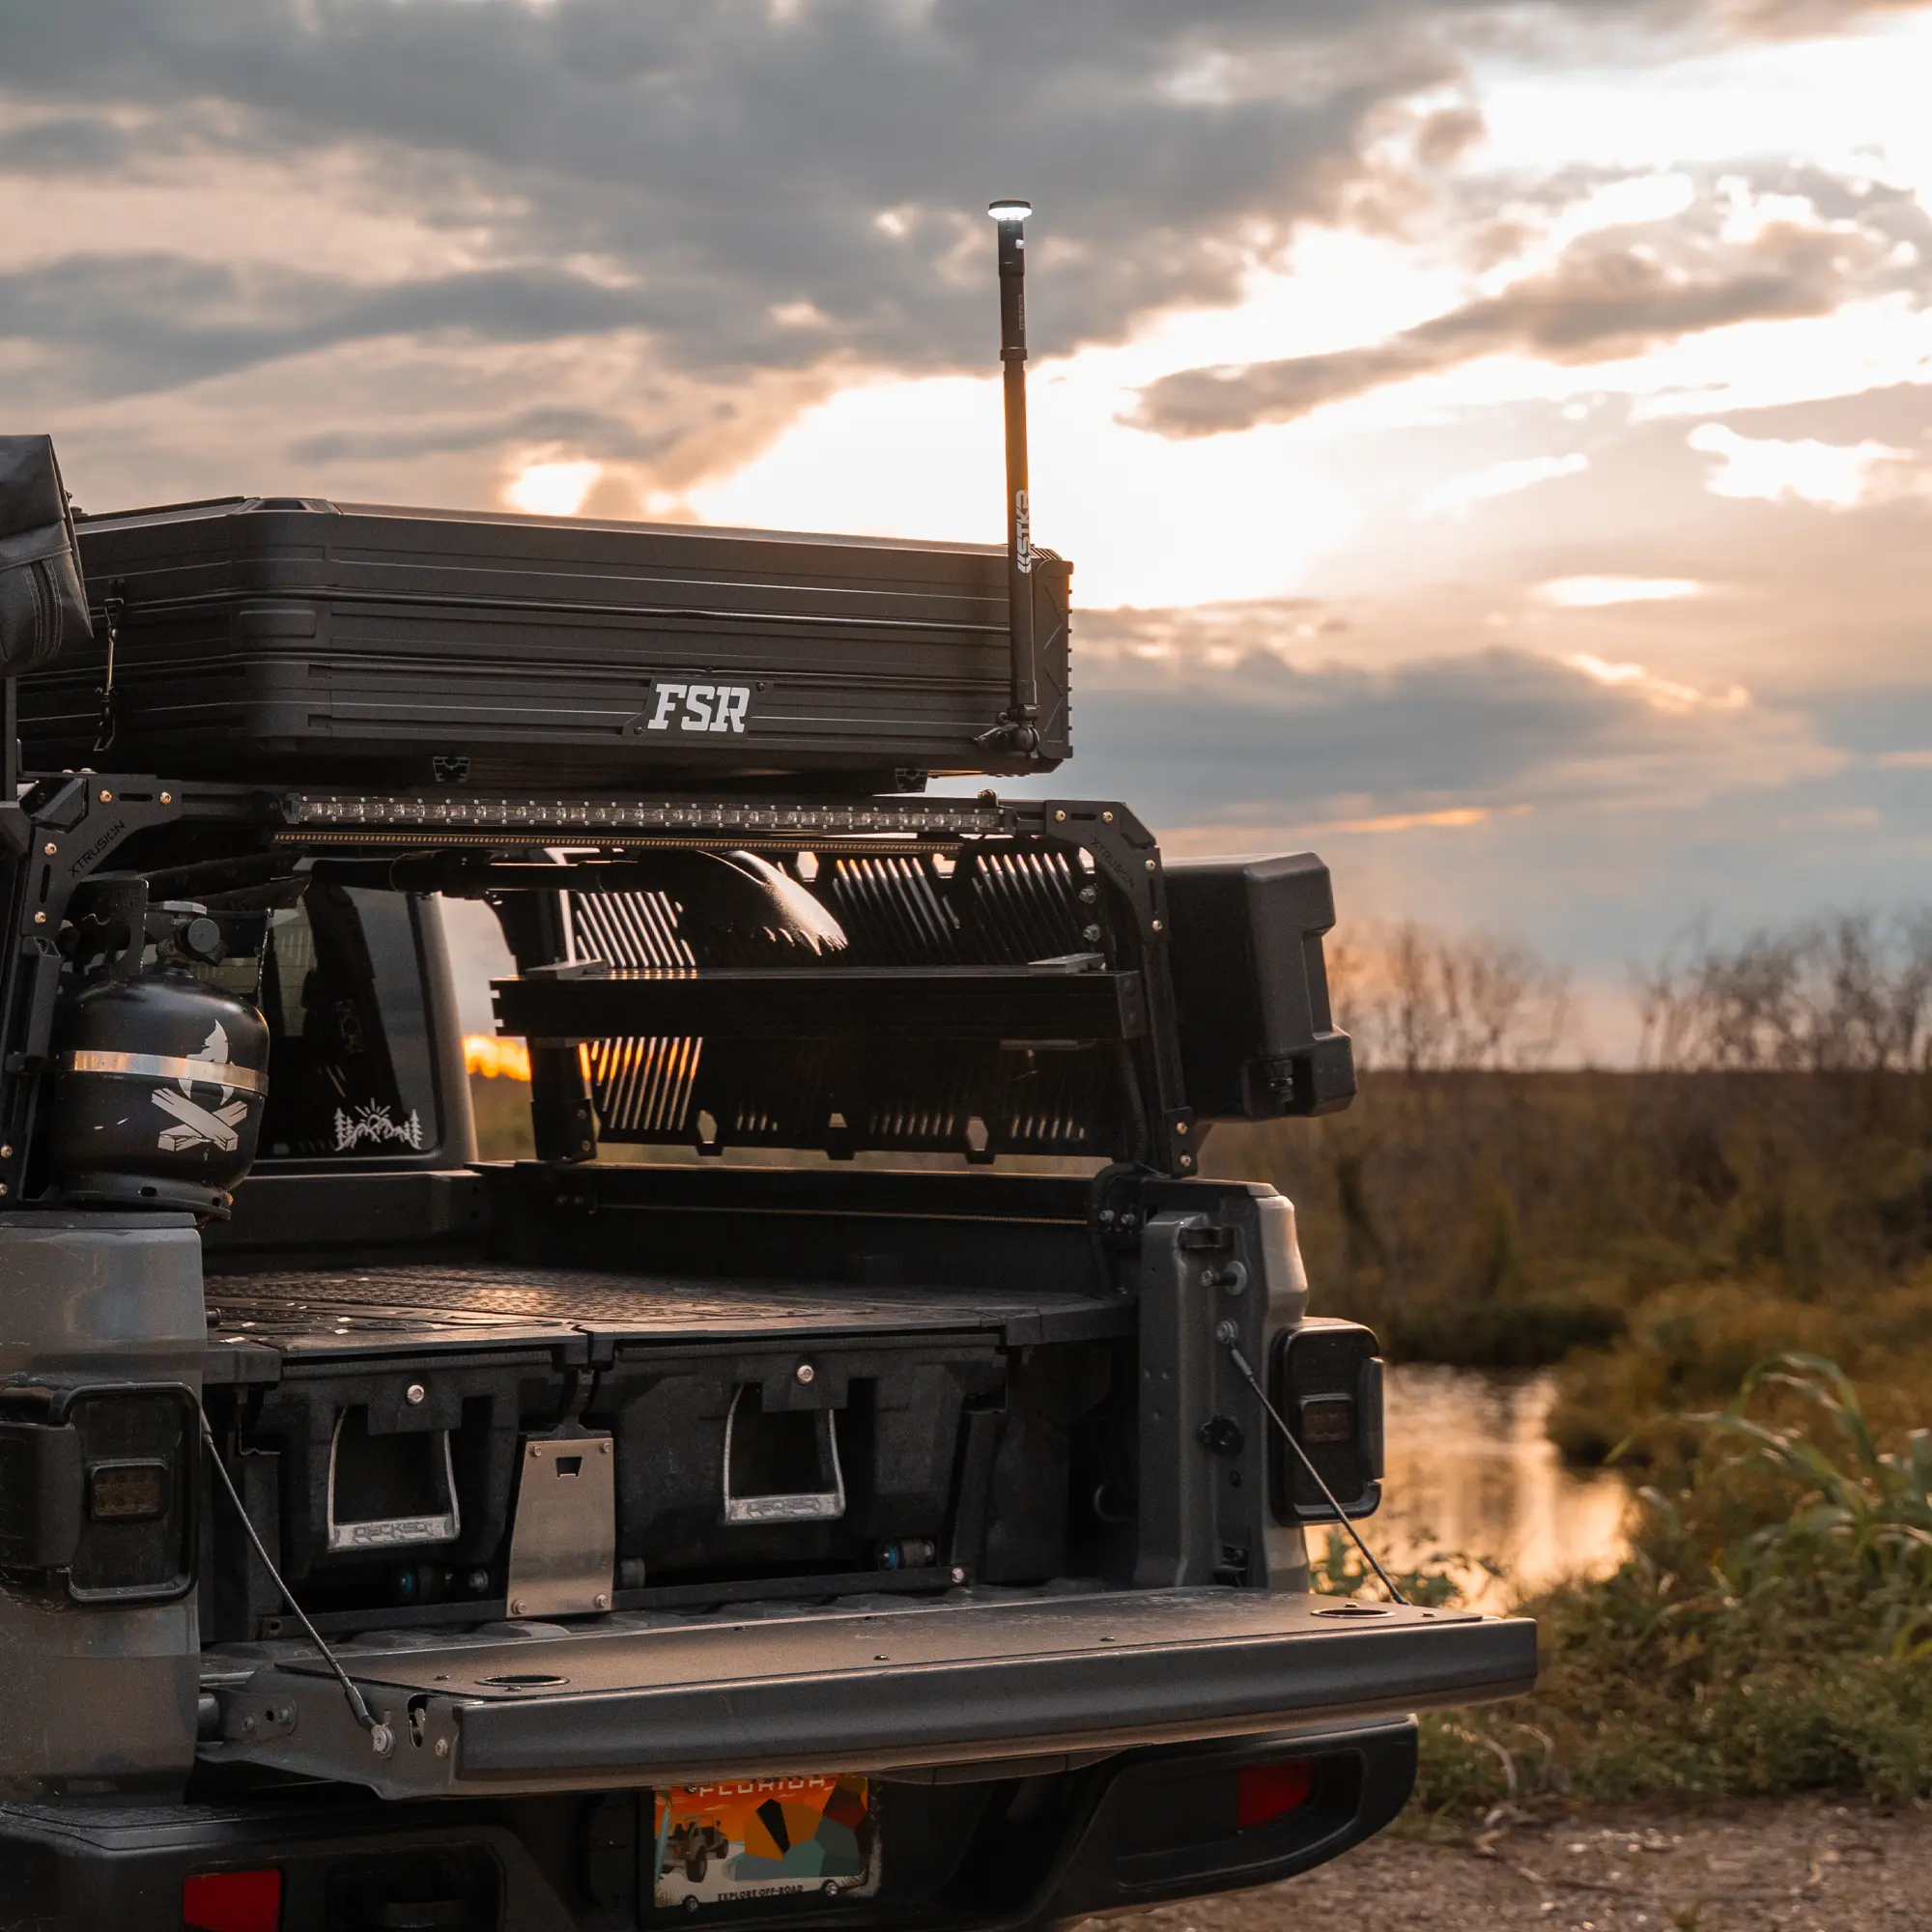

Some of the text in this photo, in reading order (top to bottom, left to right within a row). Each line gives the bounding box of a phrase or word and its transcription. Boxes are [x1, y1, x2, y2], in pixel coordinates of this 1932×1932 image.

[647, 683, 751, 733] FSR
[68, 819, 127, 877] XTRUSION
[717, 1885, 804, 1902] EXPLORE OFF-ROAD
